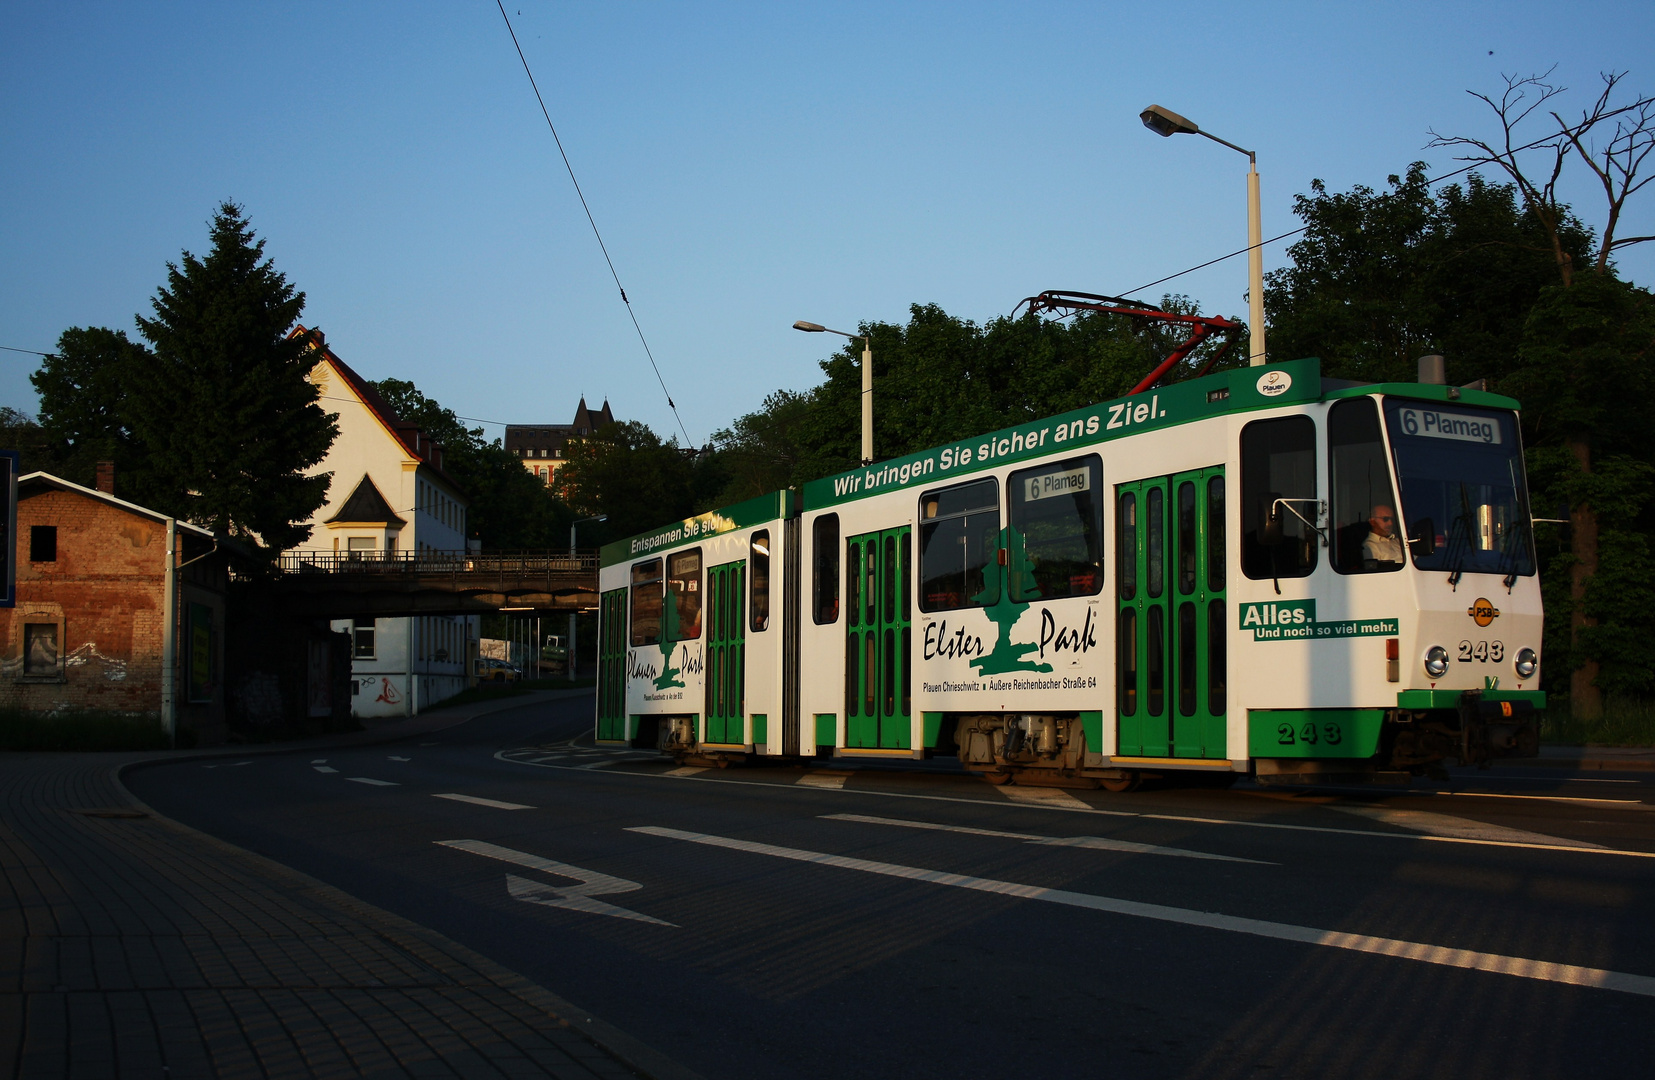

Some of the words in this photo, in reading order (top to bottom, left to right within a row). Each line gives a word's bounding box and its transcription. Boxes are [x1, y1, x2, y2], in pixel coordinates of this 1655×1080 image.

[1263, 384, 1285, 392] Plauen
[1403, 410, 1418, 435] 6
[1423, 412, 1493, 442] Plamag
[834, 475, 861, 497] Wir
[864, 457, 934, 490] bringen
[939, 446, 972, 470] Sie
[977, 427, 1049, 461] sicher
[1054, 415, 1100, 443] ans
[1106, 394, 1166, 430] Ziel.
[1031, 477, 1039, 499] 6
[1044, 472, 1084, 492] Plamag
[631, 528, 681, 554] Entspannen
[683, 519, 699, 538] Sie
[701, 513, 723, 533] sich
[1243, 604, 1312, 626] Alles.
[1476, 607, 1493, 617] PSB
[924, 620, 984, 660] Elster
[1040, 606, 1096, 659] Park
[1256, 626, 1280, 638] Und
[1283, 625, 1313, 637] noch
[1317, 627, 1331, 635] so
[1335, 623, 1356, 634] viel
[1361, 622, 1396, 633] mehr.
[1458, 640, 1504, 663] 243
[627, 651, 656, 683] Plauen
[682, 644, 703, 679] Park
[923, 682, 942, 693] Plauen
[943, 681, 979, 692] Chrieschwitz
[989, 677, 1012, 691] Äußere
[1013, 678, 1061, 690] Reichenbacher
[1062, 677, 1086, 689] Straße
[1088, 677, 1096, 688] 64
[1277, 723, 1342, 745] 243
